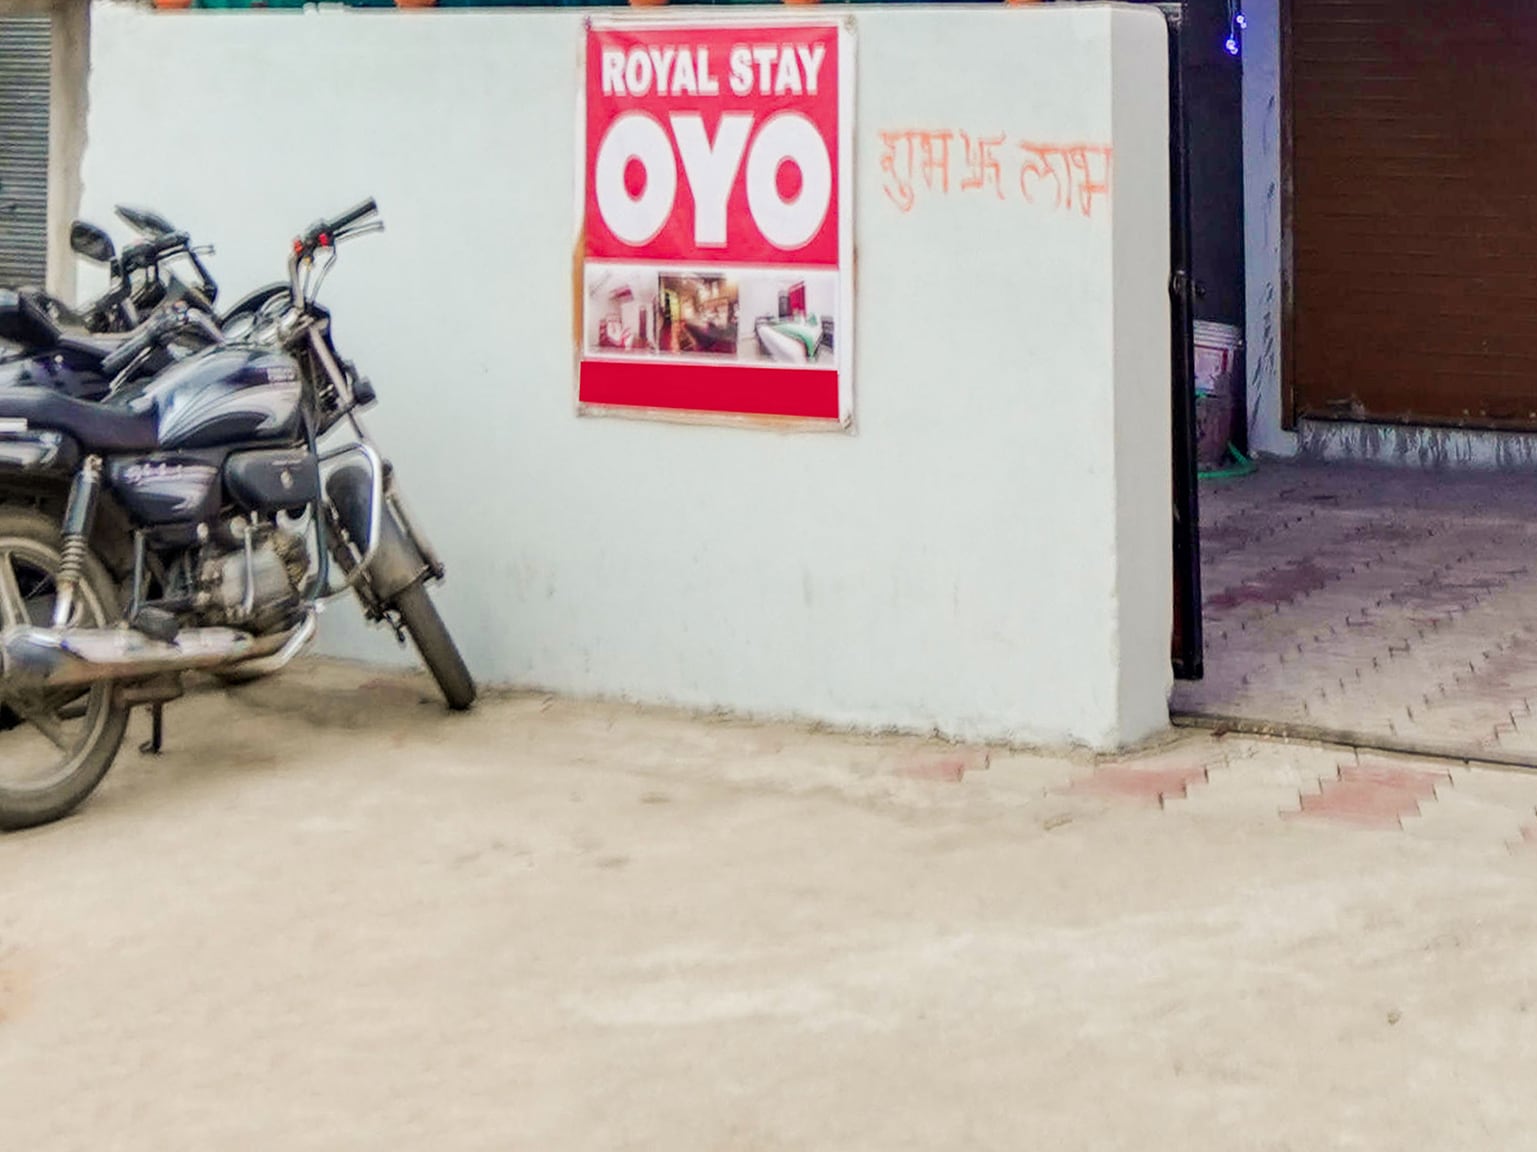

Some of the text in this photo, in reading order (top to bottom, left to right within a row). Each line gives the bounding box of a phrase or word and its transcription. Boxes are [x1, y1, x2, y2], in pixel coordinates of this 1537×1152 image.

[602, 42, 825, 97] ROYAL STAY
[595, 109, 833, 251] OYO
